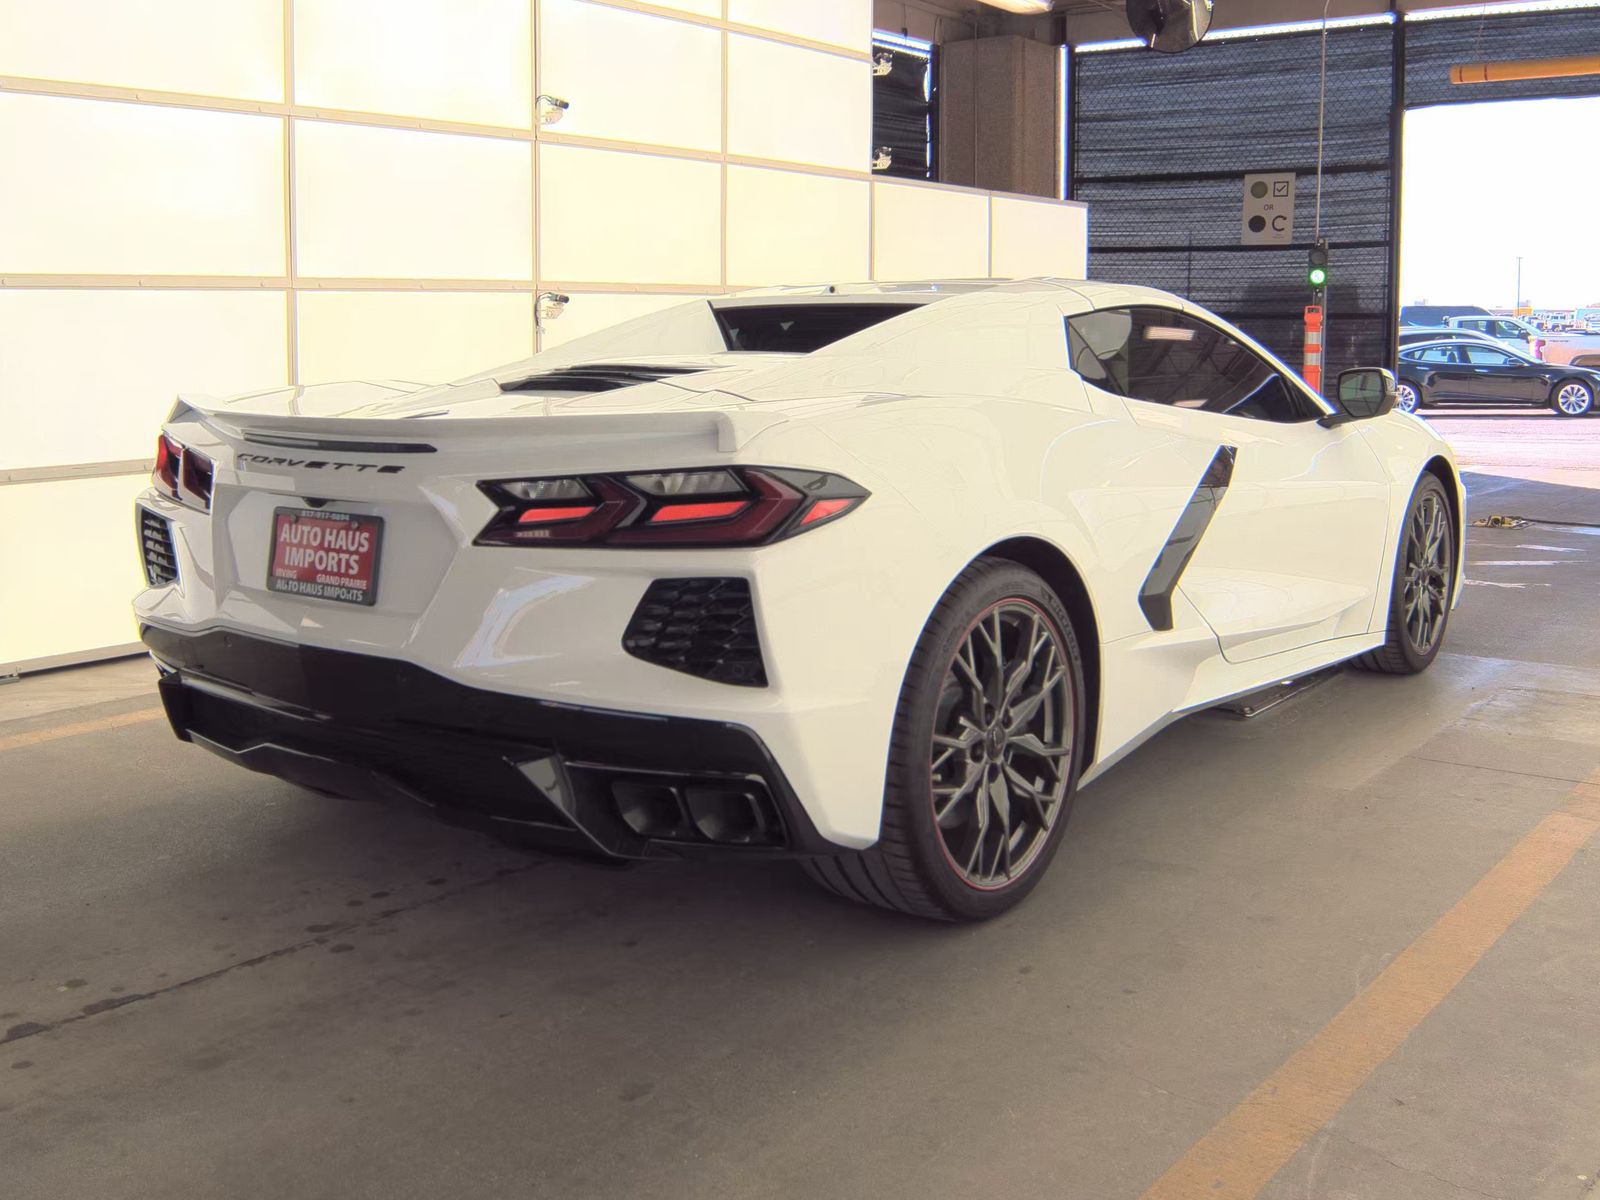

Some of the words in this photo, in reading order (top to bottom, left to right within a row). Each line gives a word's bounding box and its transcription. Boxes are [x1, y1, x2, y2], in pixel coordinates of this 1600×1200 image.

[1263, 203, 1274, 212] OR
[237, 453, 405, 474] CORVETTE
[280, 523, 321, 547] AUTO
[324, 528, 370, 553] HAUS
[284, 546, 359, 575] IMPORTS
[299, 582, 322, 596] HAUS
[316, 574, 339, 587] GRAND
[340, 577, 367, 590] PRAIRIE
